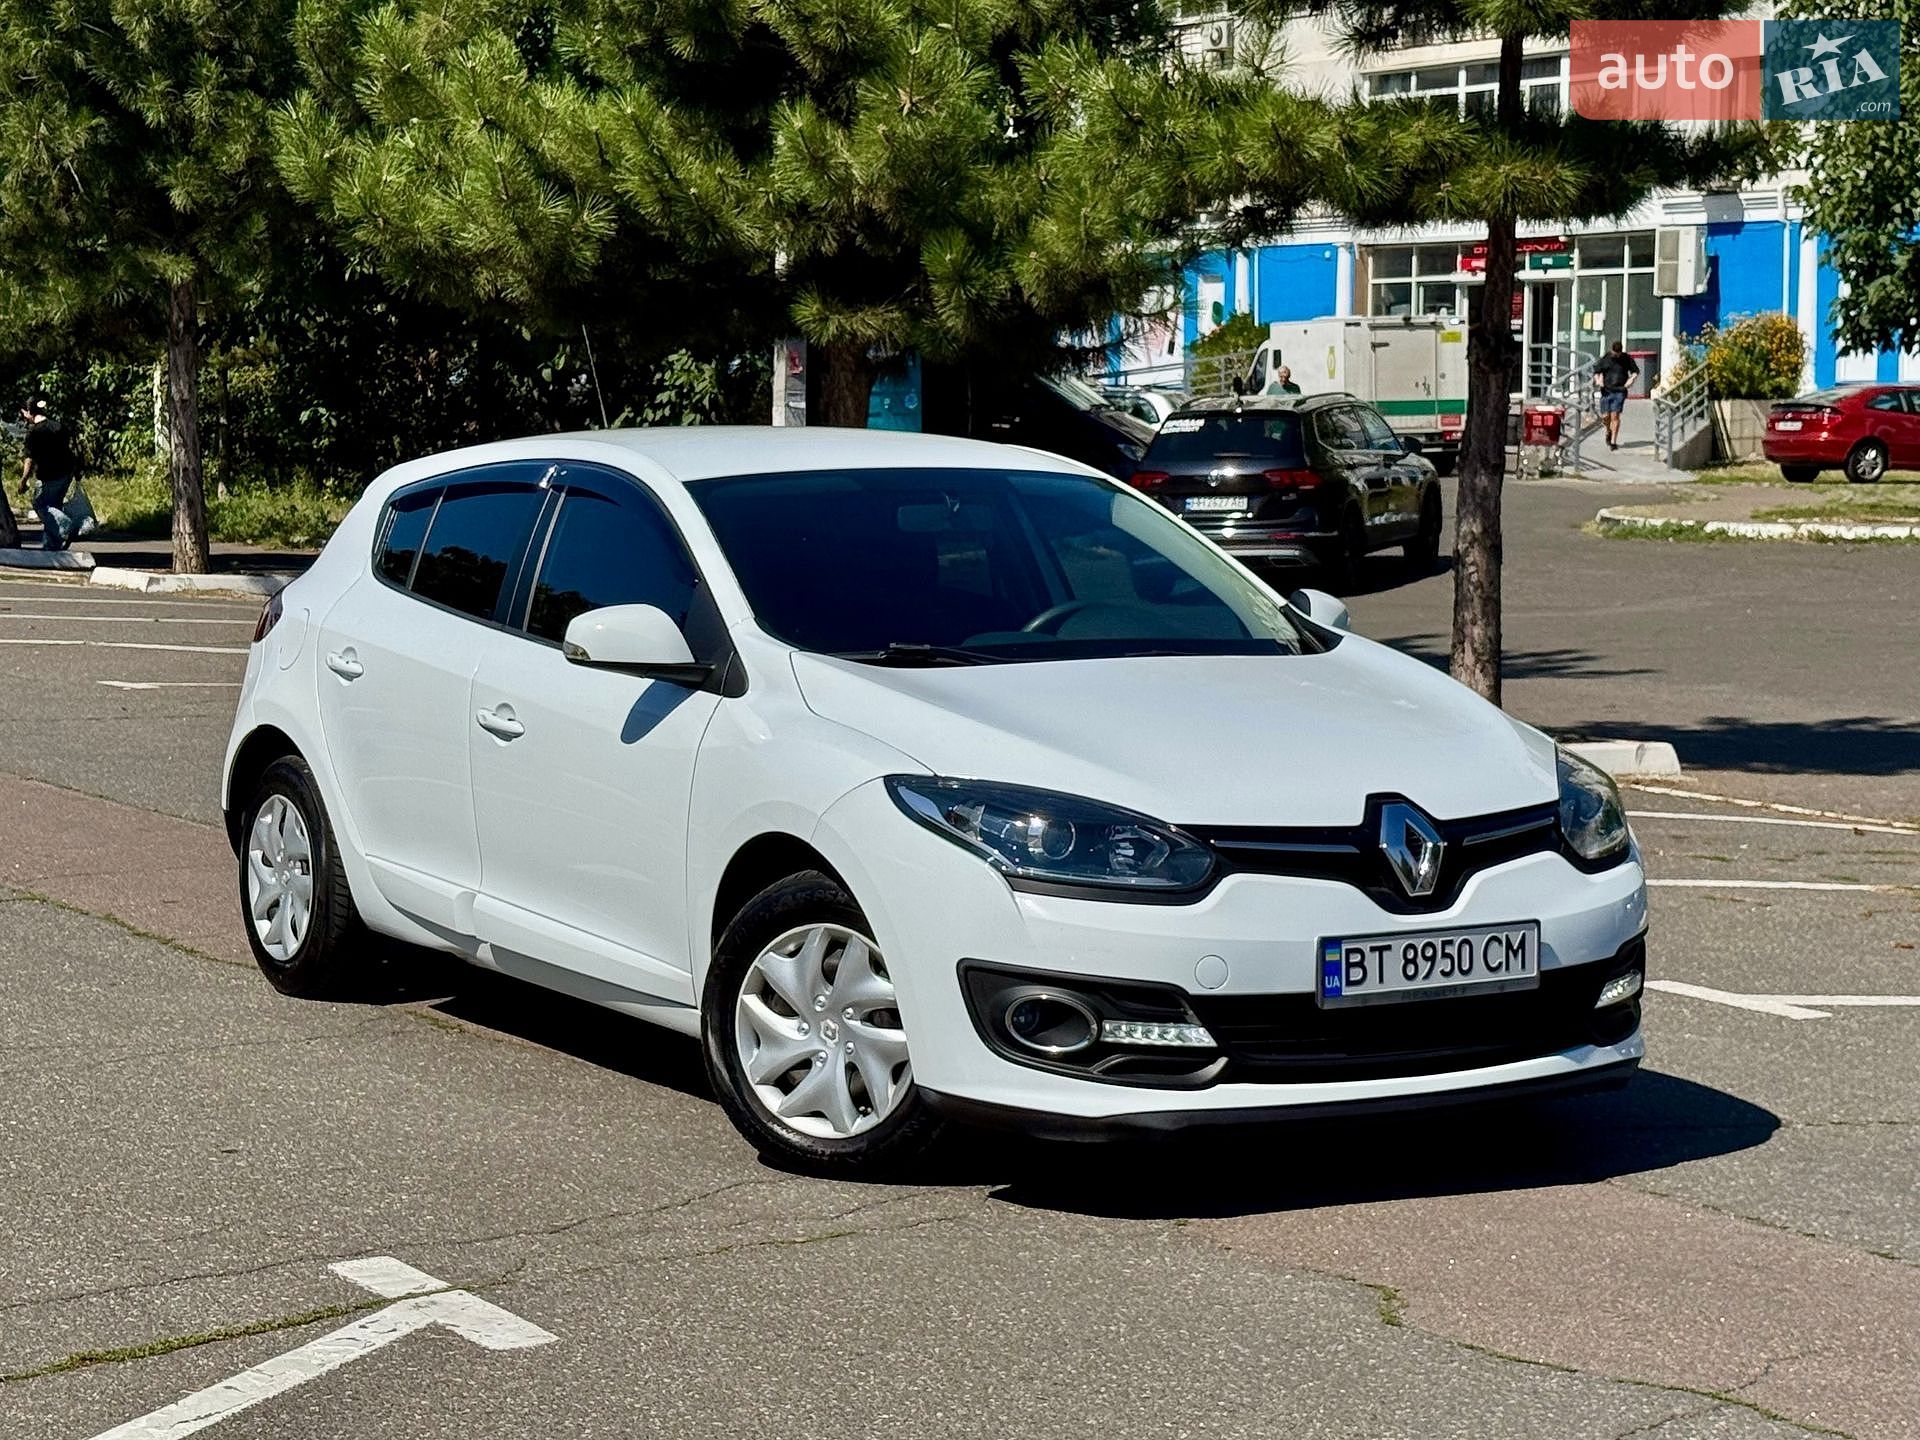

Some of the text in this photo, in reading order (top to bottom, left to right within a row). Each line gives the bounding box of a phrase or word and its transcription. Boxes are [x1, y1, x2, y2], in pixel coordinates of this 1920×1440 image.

[1344, 931, 1527, 987] BT 8950 CM
[1325, 975, 1341, 988] UA
